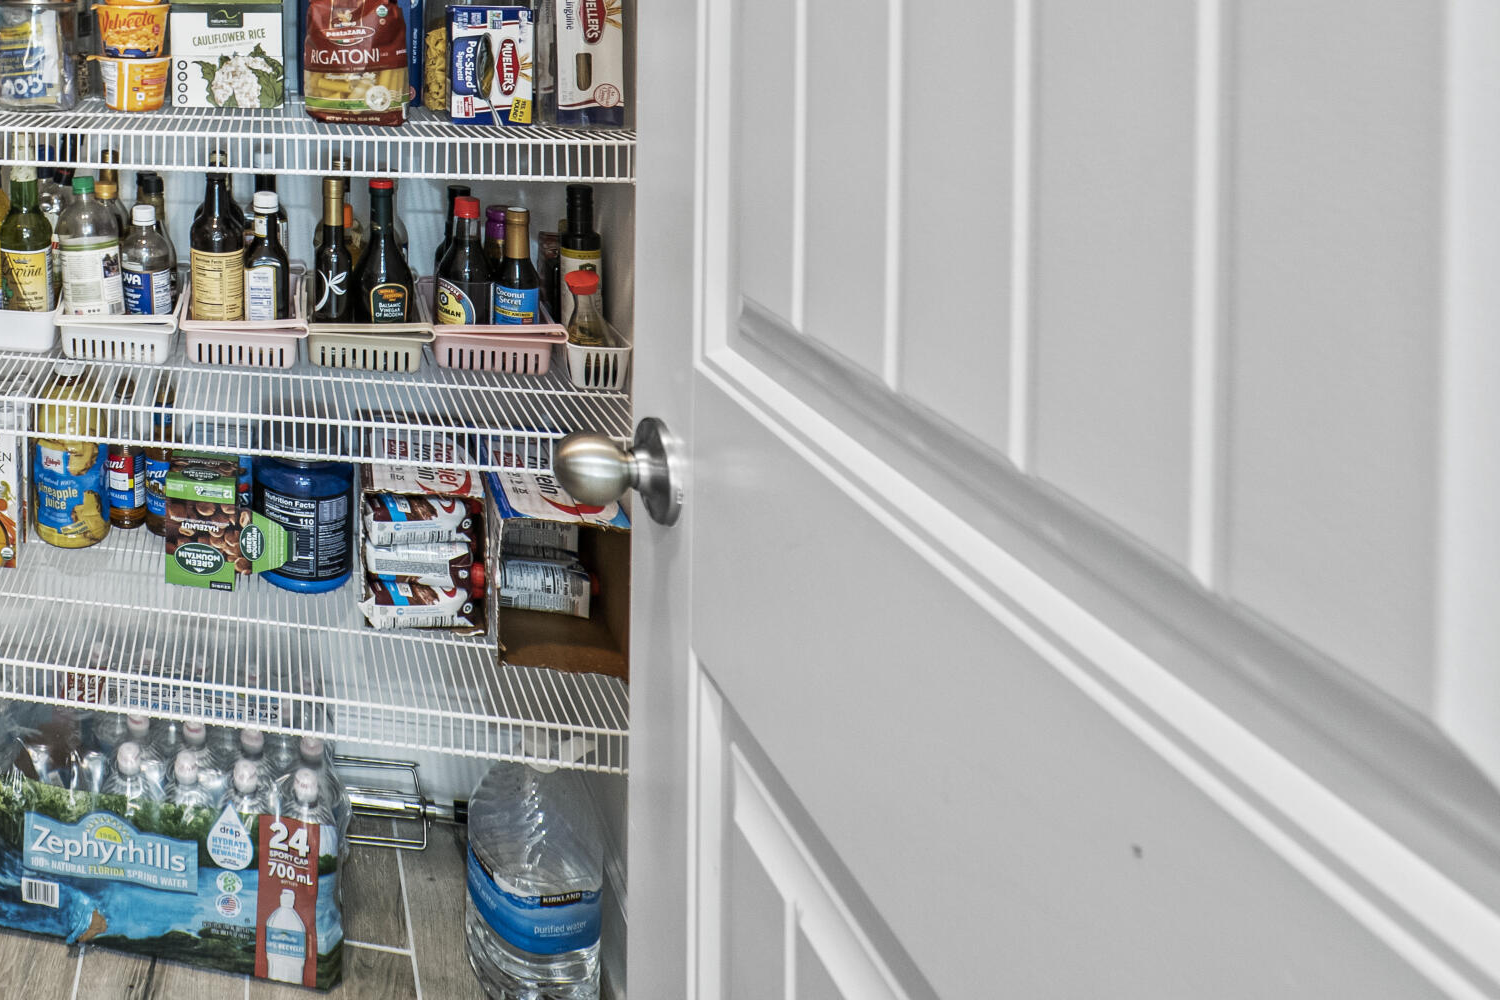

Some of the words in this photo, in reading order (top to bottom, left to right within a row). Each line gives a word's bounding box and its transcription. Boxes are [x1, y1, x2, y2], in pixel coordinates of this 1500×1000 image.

[101, 10, 156, 34] Velveeta
[192, 30, 246, 47] CAULIFLOWER
[247, 27, 267, 41] RICE
[310, 47, 380, 65] RIGATONI
[455, 51, 465, 82] Spaghetti
[464, 40, 478, 90] Pot-Sized
[501, 42, 516, 92] MUELLER'S
[496, 286, 525, 299] Coconut
[499, 296, 522, 306] Secret
[45, 494, 67, 511] juice
[222, 489, 233, 499] 12
[264, 490, 293, 507] Nutrition
[294, 500, 316, 510] Facts
[264, 507, 289, 523] Calories
[300, 517, 315, 526] 110
[180, 520, 220, 533] HAZELNUT
[178, 550, 221, 562] MOUNTAIN
[185, 558, 214, 568] GREEN
[30, 823, 188, 873] Zephyrhills
[211, 835, 248, 850] HYDRATE
[268, 821, 311, 858] 24
[211, 847, 248, 862] REWARDS!
[268, 850, 294, 863] SPORT
[293, 856, 309, 867] CAP
[51, 861, 87, 876] NATURAL
[87, 865, 125, 878] FLORIDA
[126, 869, 159, 885] SPRING
[159, 876, 189, 890] WATER
[267, 861, 296, 881] 700
[296, 873, 314, 887] mL
[542, 892, 582, 904] KIRKLAND
[533, 923, 566, 937] purified
[565, 920, 588, 932] water
